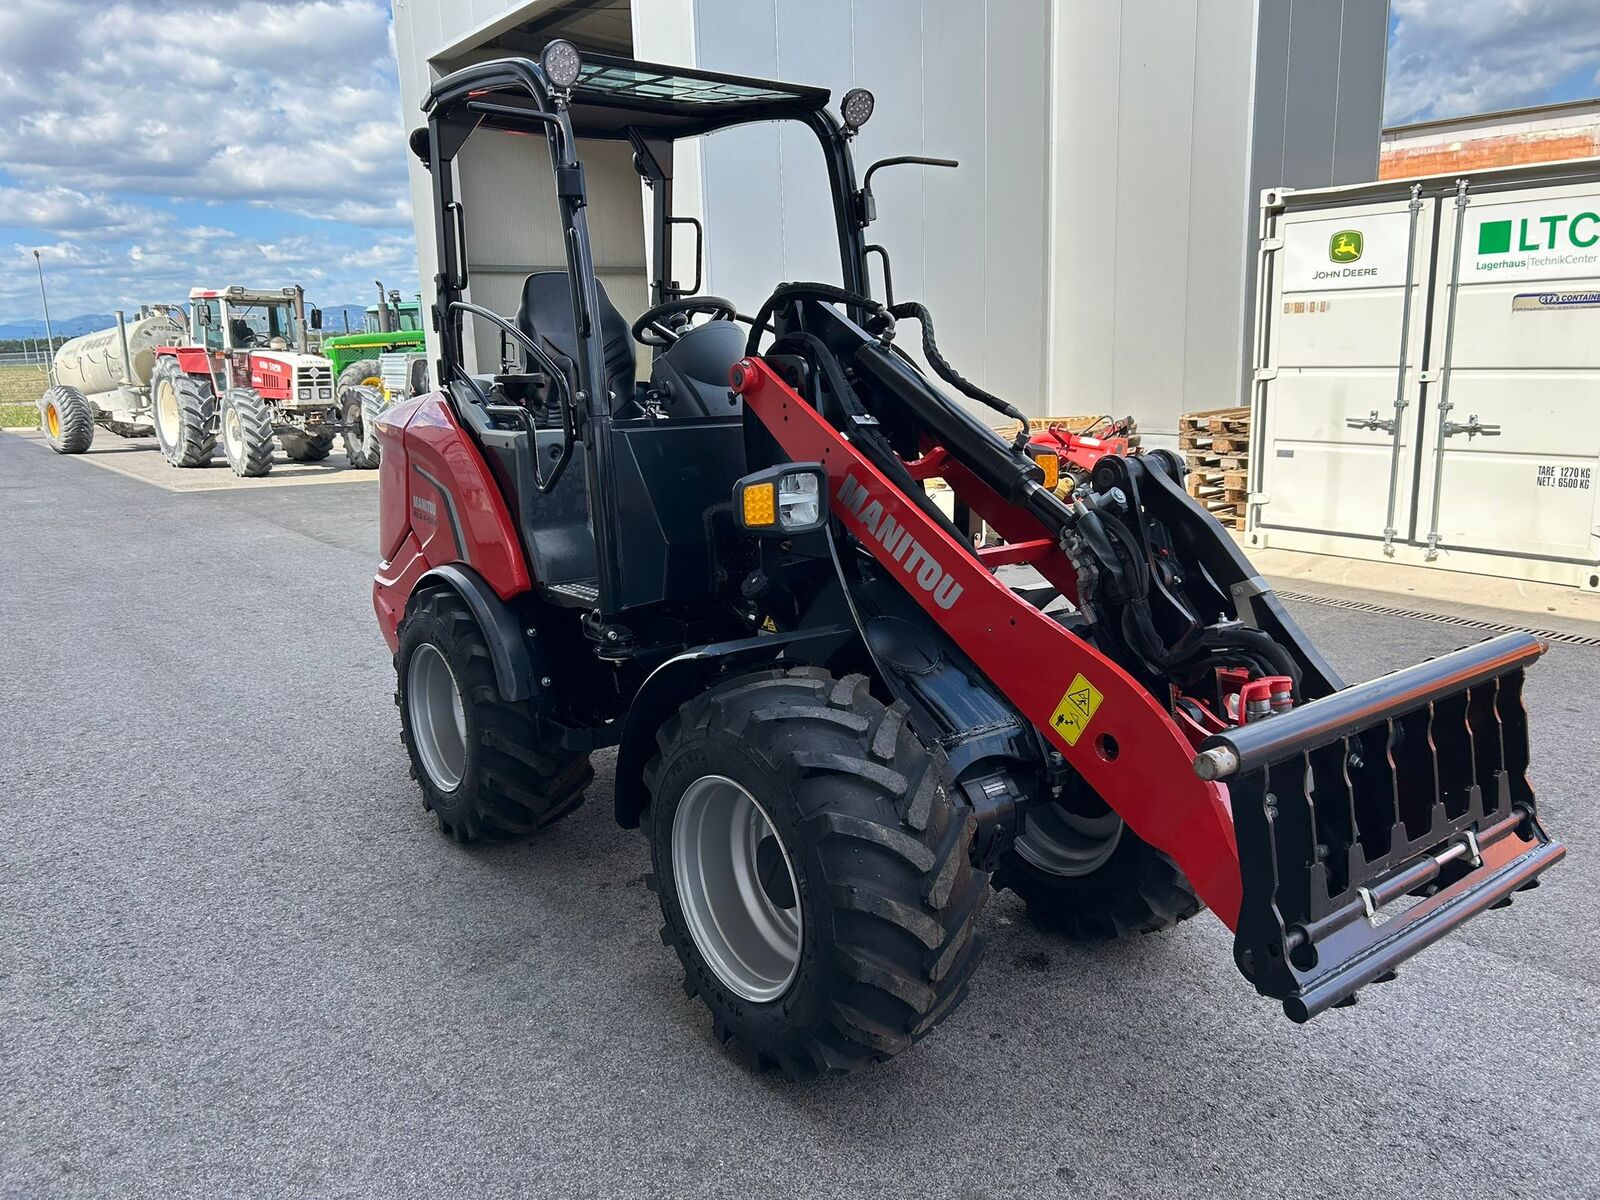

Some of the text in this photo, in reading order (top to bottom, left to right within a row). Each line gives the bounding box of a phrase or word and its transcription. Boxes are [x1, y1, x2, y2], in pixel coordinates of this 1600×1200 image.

[1518, 211, 1600, 251] LTC
[1476, 254, 1598, 271] Lagerhaus TechnikCenter
[1312, 267, 1378, 280] JOHN DEERE
[1538, 465, 1591, 479] TARE 1270 KG
[1558, 477, 1579, 489] 6500
[1579, 478, 1590, 490] KG
[836, 473, 964, 610] MANITOU
